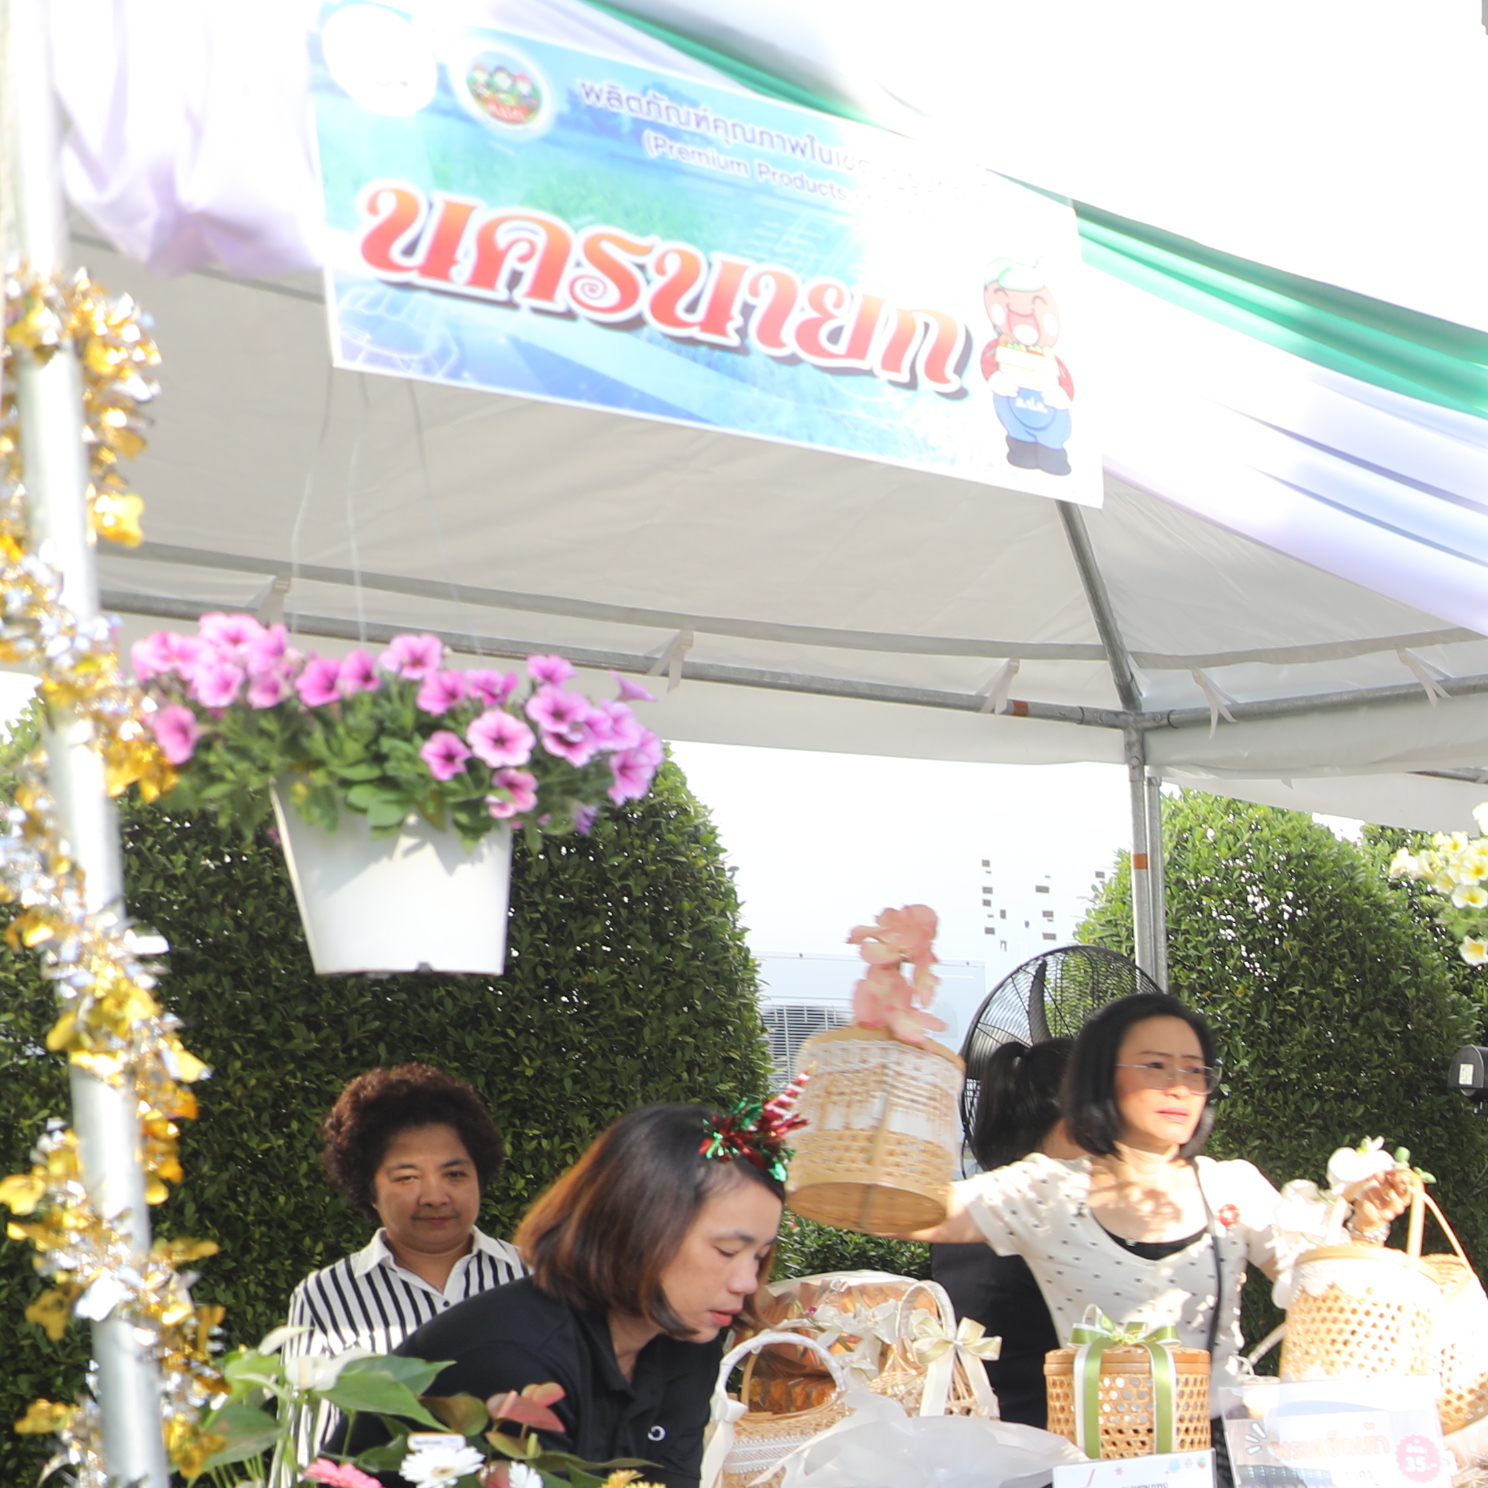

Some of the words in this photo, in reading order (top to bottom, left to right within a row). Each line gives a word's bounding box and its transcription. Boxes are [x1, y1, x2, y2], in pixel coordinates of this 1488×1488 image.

[757, 161, 848, 203] Products
[356, 180, 968, 396] นครนายก
